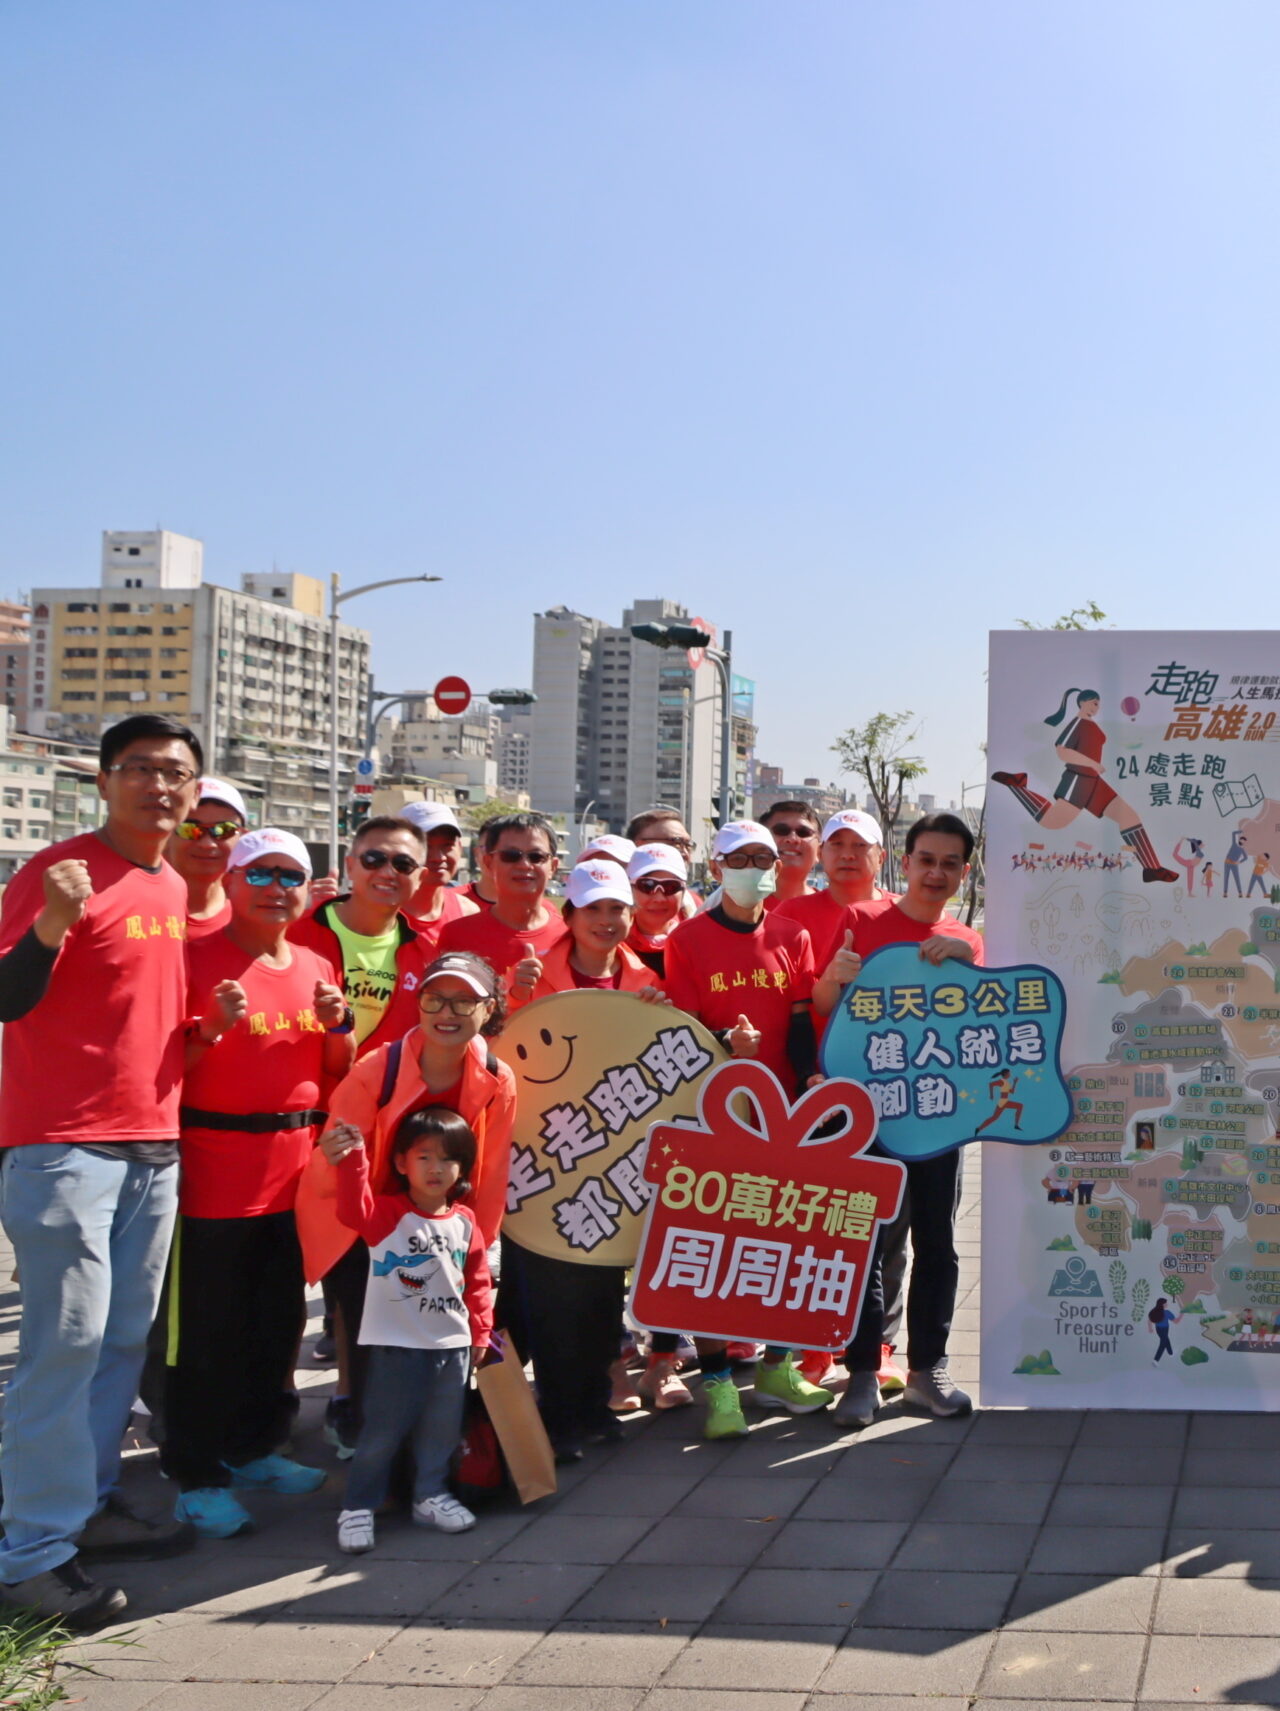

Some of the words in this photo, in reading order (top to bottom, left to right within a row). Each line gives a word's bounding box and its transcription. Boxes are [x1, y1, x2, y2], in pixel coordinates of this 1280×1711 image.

[1144, 661, 1220, 705] 走跑
[1163, 704, 1248, 742] 高雄
[1248, 712, 1277, 729] 2.0
[1243, 729, 1267, 741] RUN
[1116, 754, 1140, 779] 24
[1145, 752, 1227, 779] 處走跑
[1149, 782, 1204, 809] 景點
[710, 969, 789, 993] 鳳山慢跑
[850, 978, 1052, 1023] 每天3公里
[249, 1009, 327, 1035] 鳳山慢
[866, 1023, 1045, 1072] 健人就是
[869, 1077, 955, 1118] 腳勤
[661, 1165, 878, 1242] 80萬好禮
[408, 1235, 450, 1253] SUPER
[648, 1226, 857, 1317] 周周抽
[1059, 1301, 1118, 1319] Sports
[1054, 1318, 1134, 1336] Treasure
[1079, 1336, 1118, 1353] Hunt
